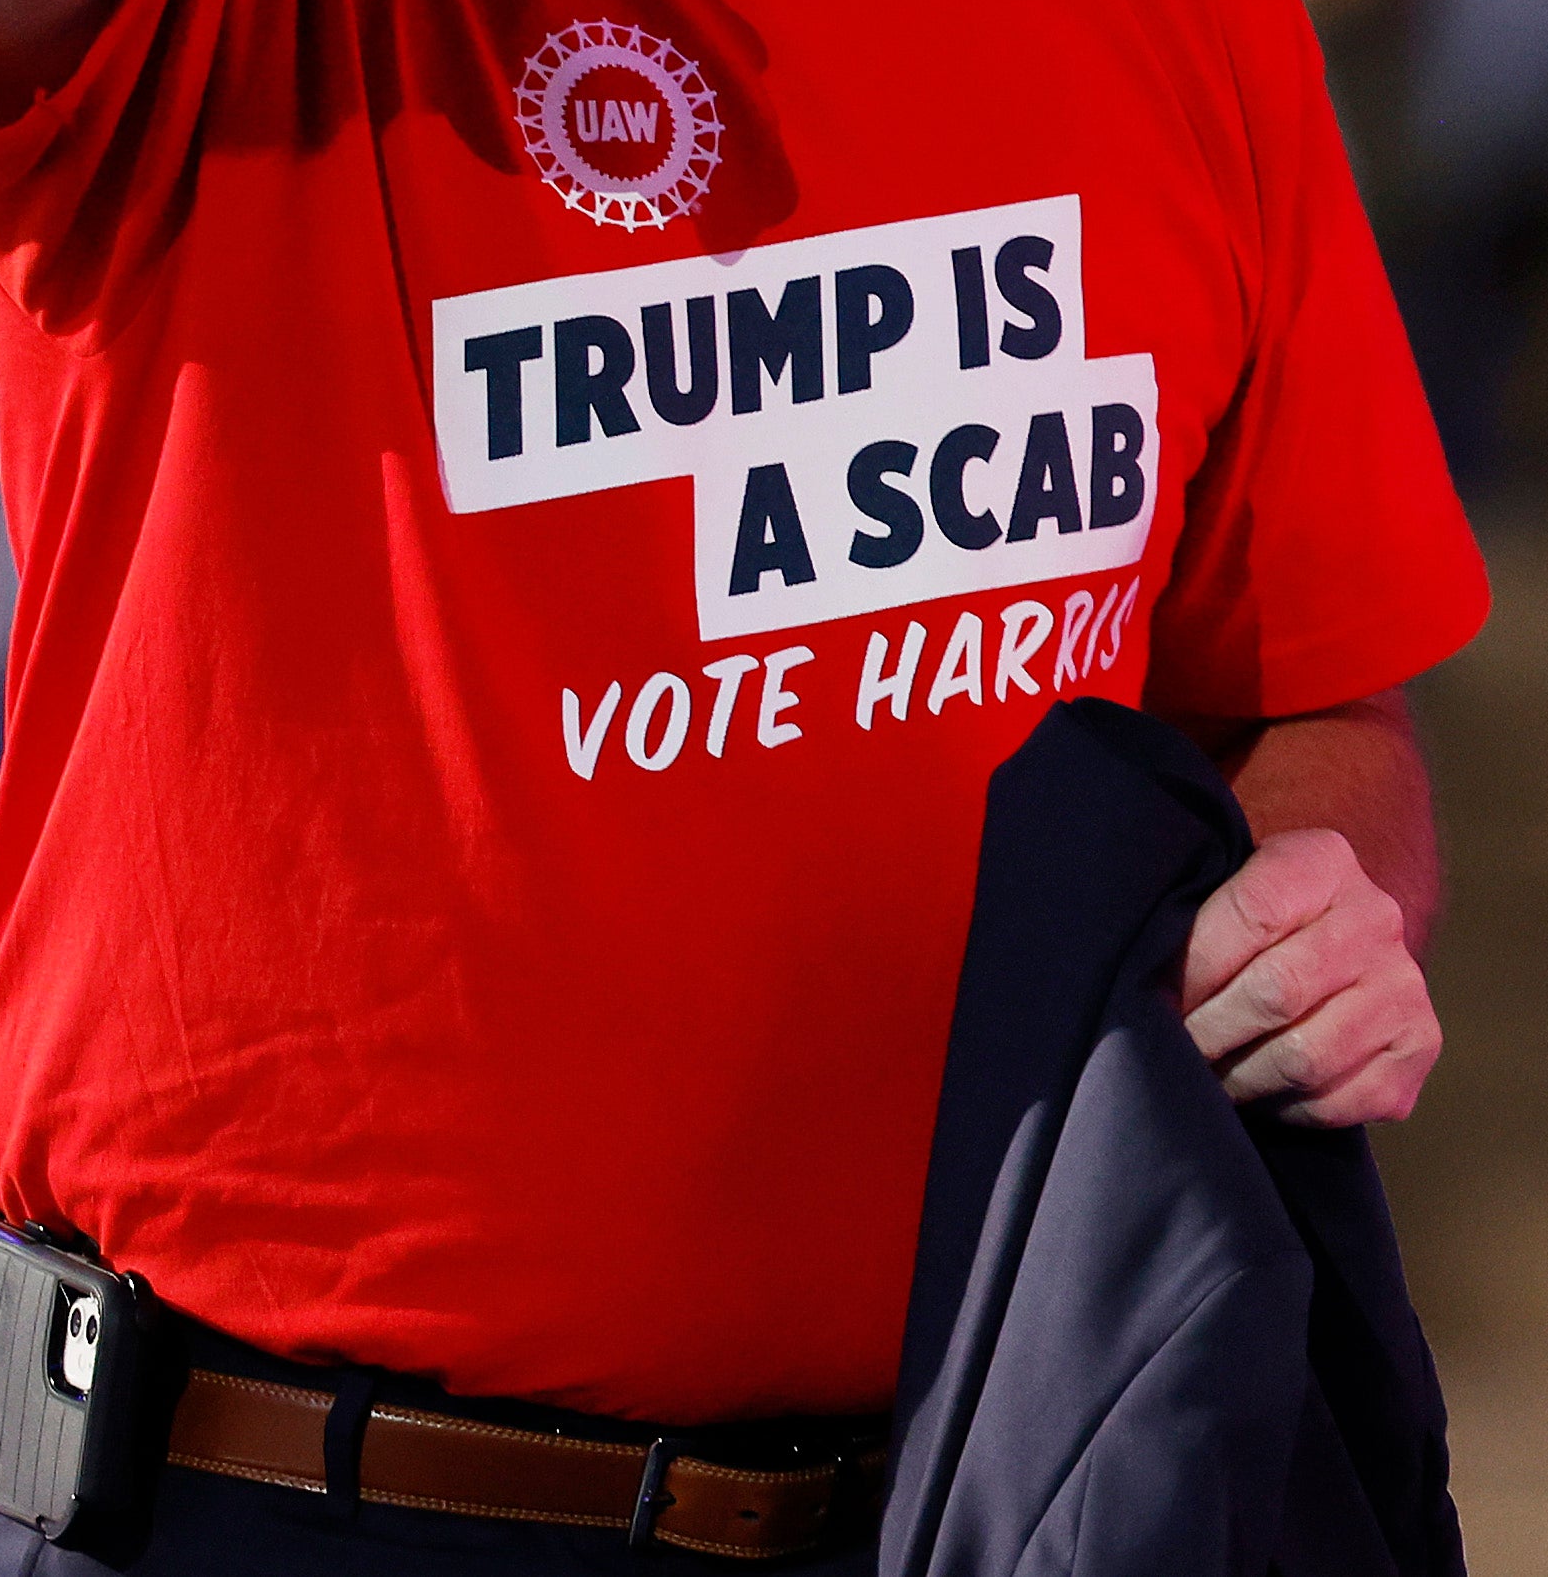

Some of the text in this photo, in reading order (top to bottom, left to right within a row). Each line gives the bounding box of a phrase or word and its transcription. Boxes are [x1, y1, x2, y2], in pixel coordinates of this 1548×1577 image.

[574, 99, 659, 144] UAW
[464, 234, 1063, 460] TRUMP IS
[728, 402, 1146, 597] A SCAB
[561, 575, 1140, 781] VOTE HARRIS
